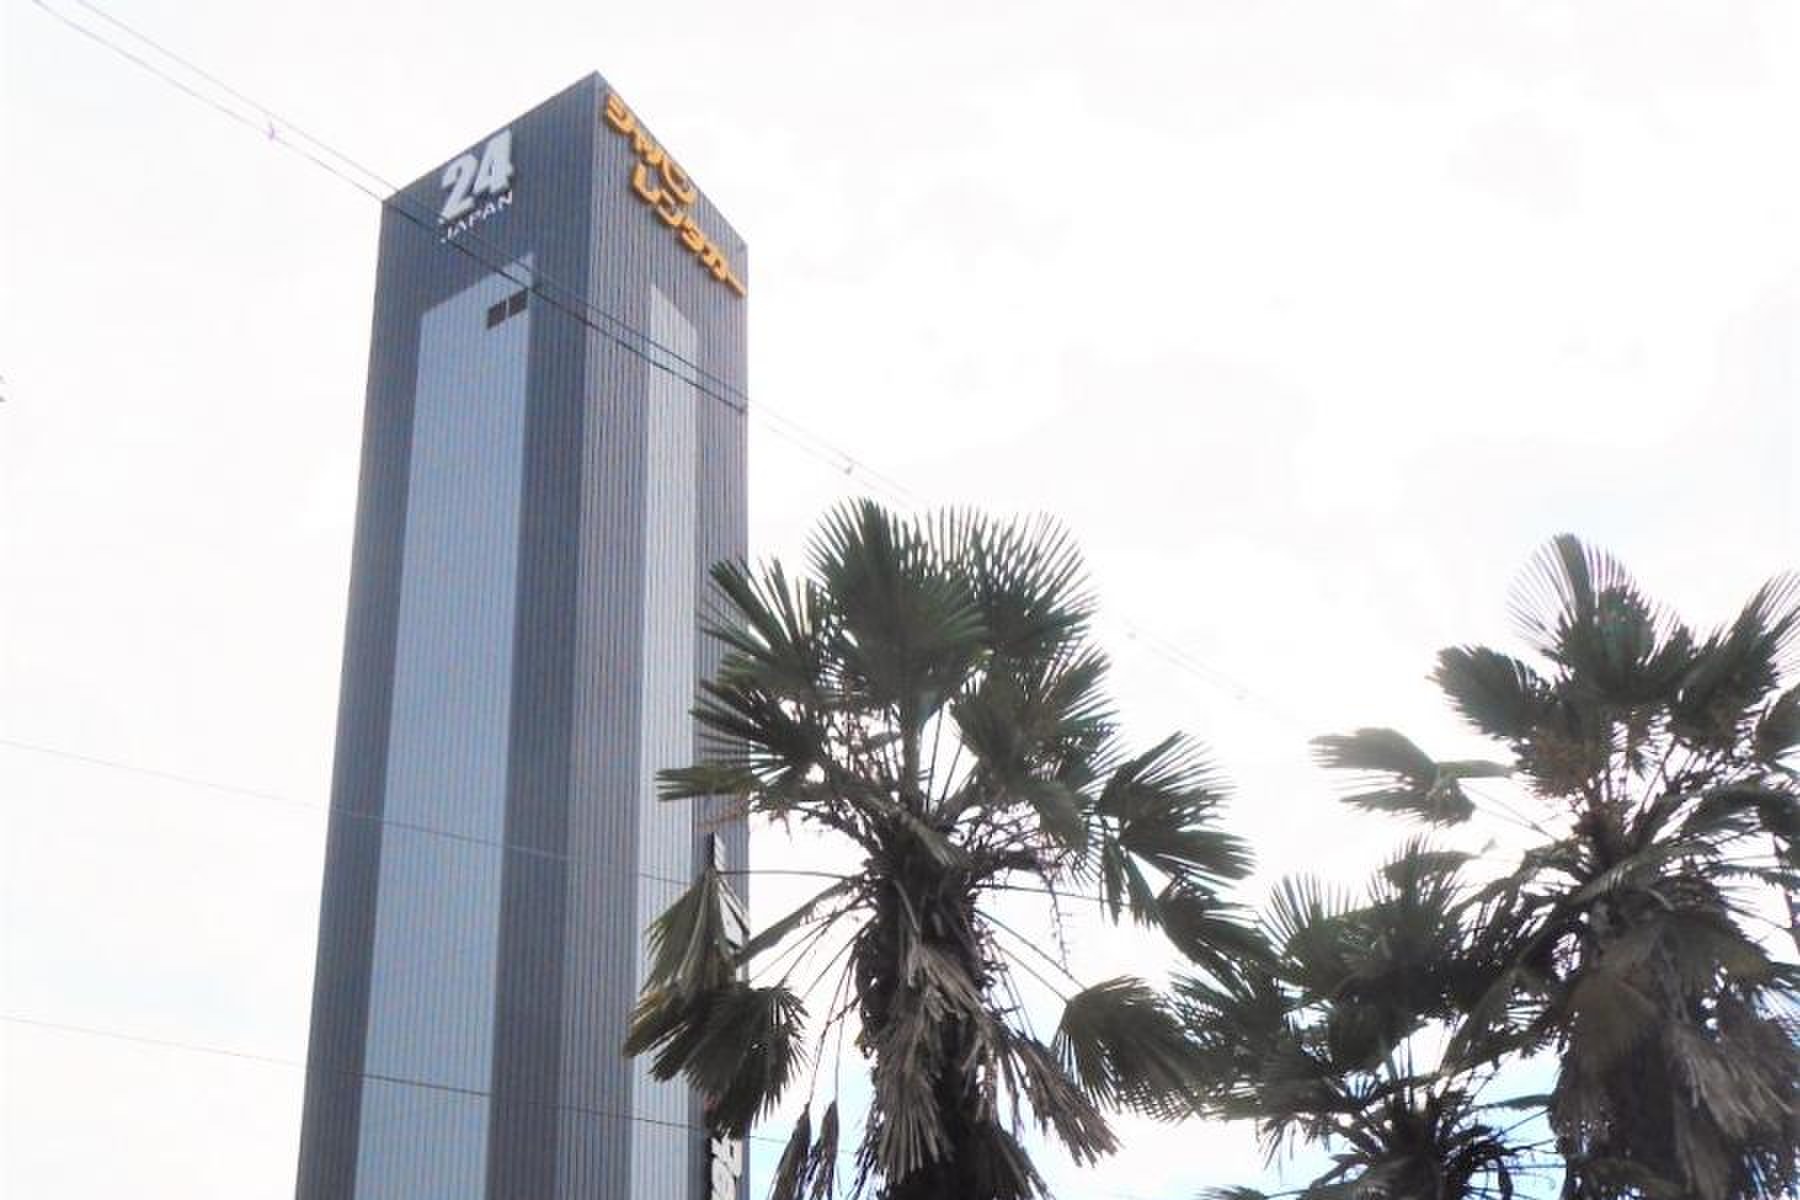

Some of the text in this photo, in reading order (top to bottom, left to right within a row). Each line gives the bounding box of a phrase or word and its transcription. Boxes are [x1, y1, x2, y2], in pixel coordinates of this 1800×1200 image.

[440, 128, 513, 220] 24
[606, 92, 697, 205] ジャパン
[438, 188, 513, 243] JAPAN
[632, 161, 748, 298] レンタカー
